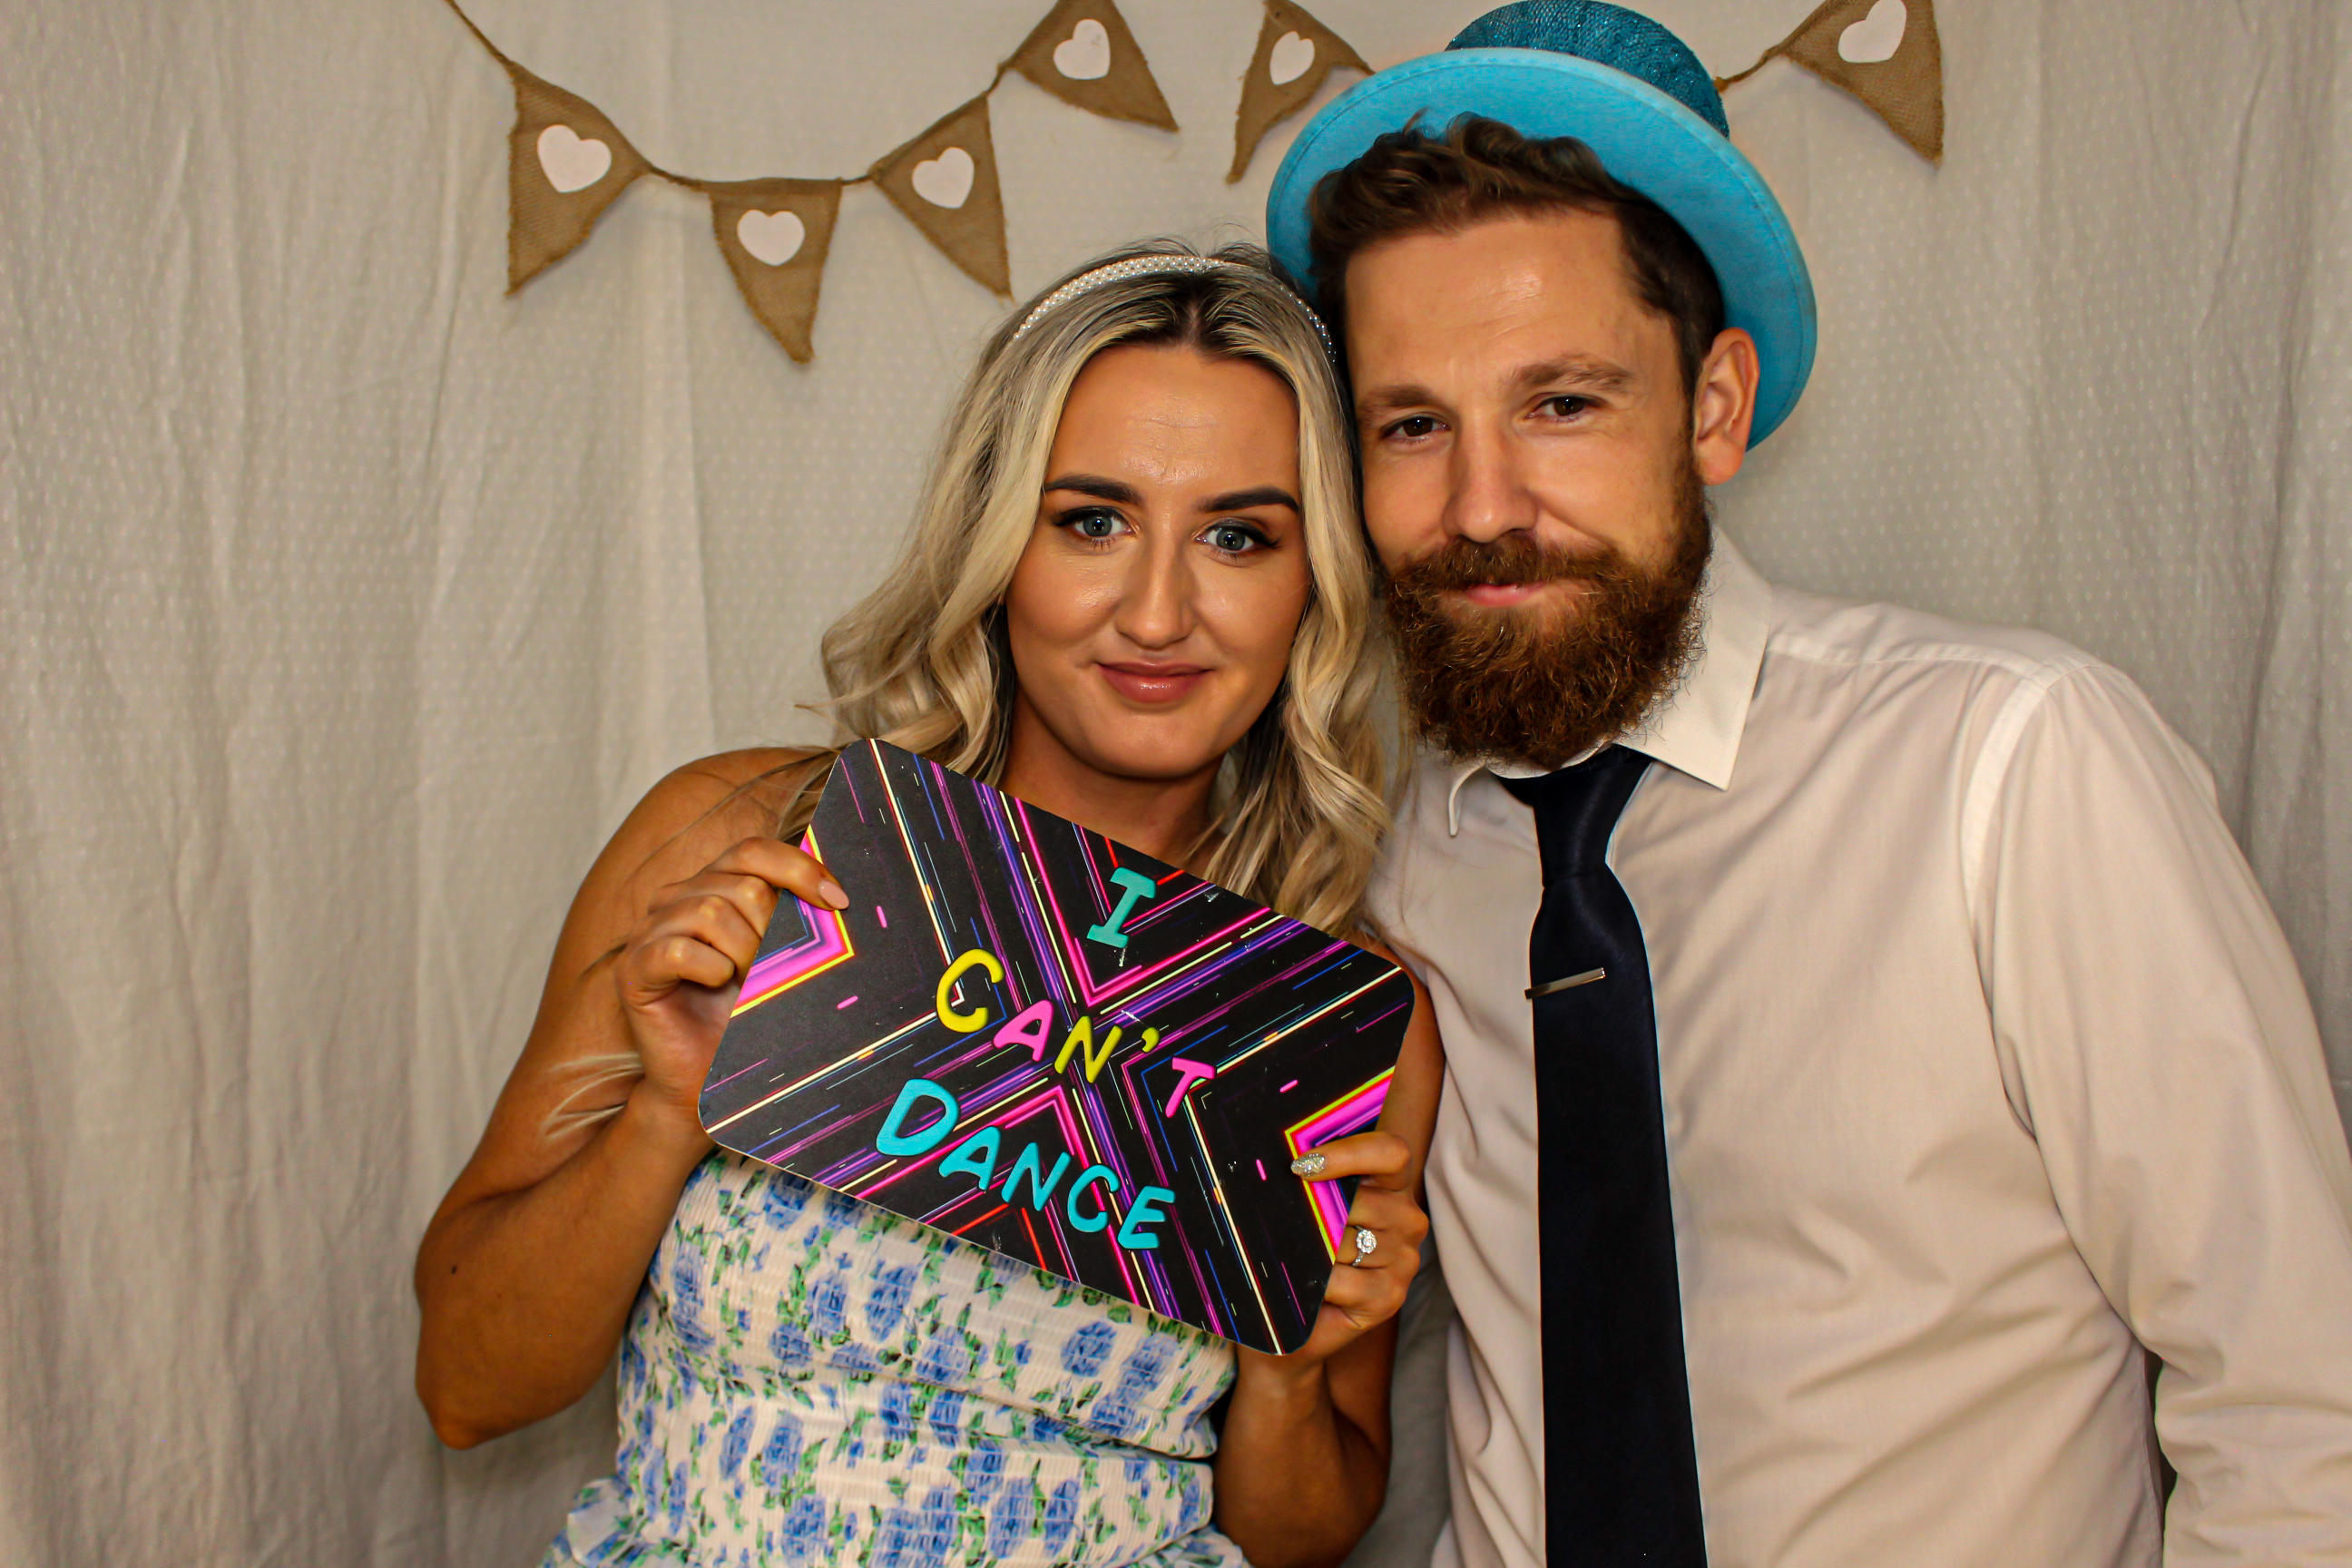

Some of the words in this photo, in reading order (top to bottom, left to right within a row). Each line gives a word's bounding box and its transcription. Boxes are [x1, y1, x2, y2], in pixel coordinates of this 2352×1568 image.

[1086, 866, 1157, 948] I
[936, 948, 1218, 1118] CAN'T
[876, 1078, 1176, 1250] DANCE
